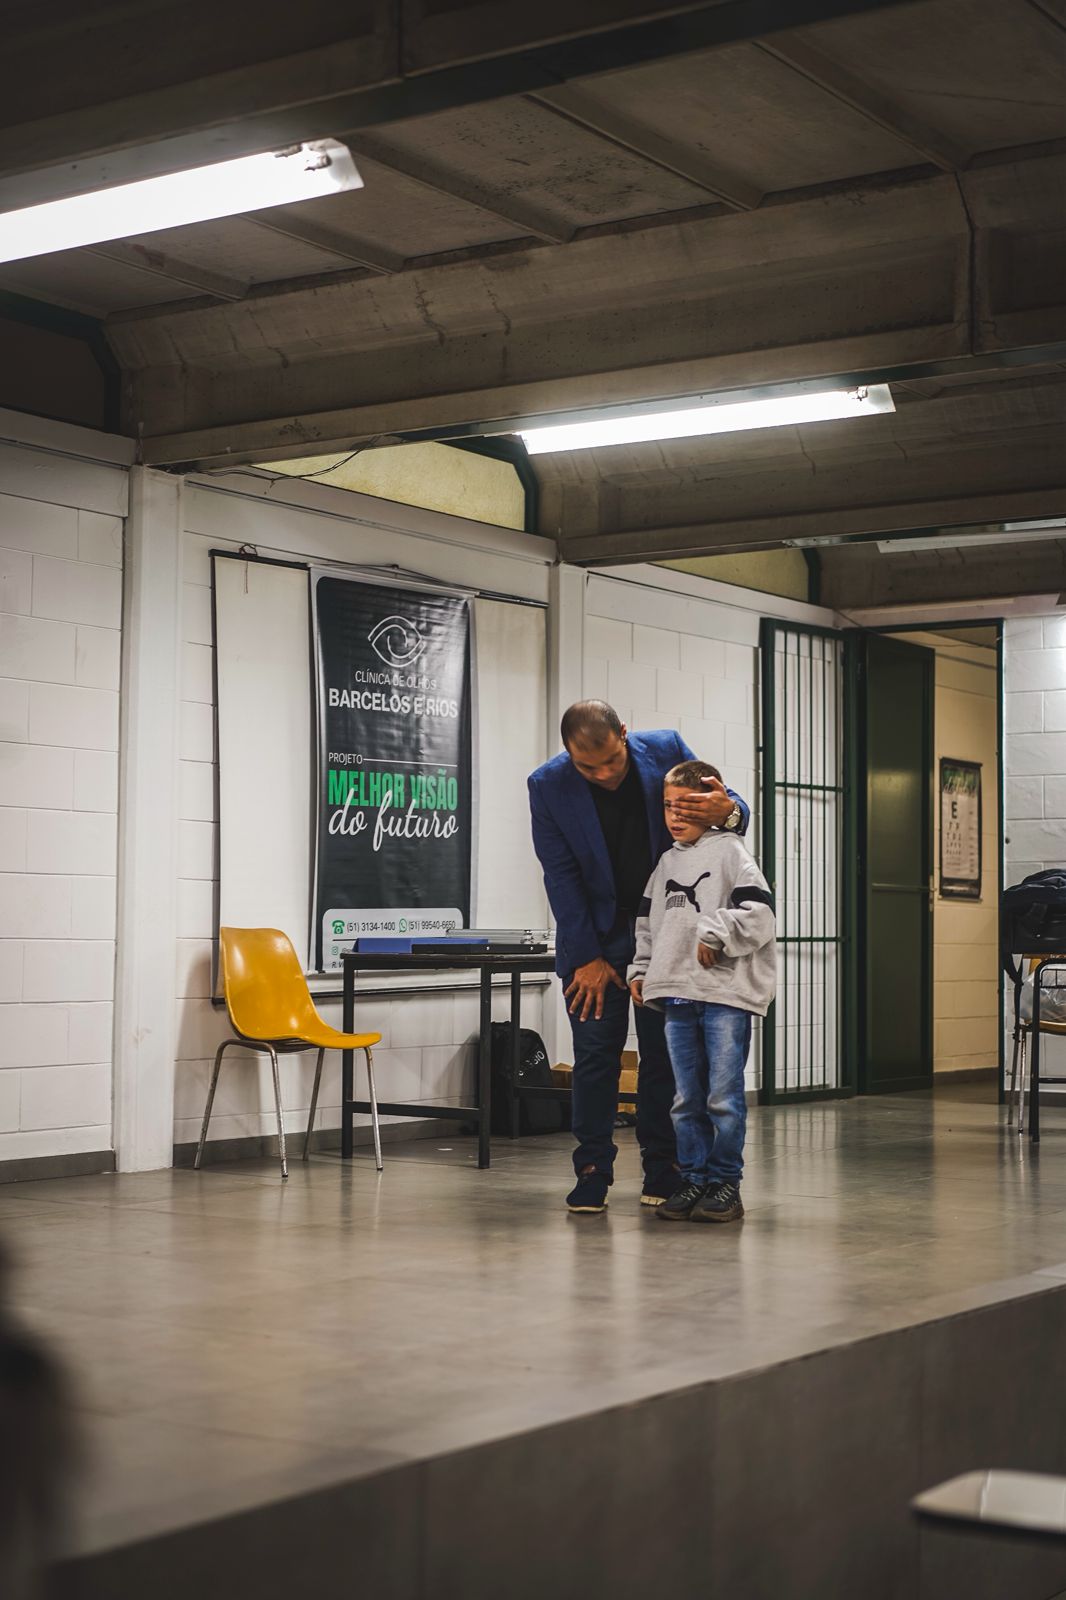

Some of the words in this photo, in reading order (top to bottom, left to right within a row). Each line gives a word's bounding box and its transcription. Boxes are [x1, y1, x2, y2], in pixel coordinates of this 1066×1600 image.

[355, 668, 391, 686] CLÍNICA
[392, 674, 405, 687] DE
[406, 675, 437, 690] OLHOS
[328, 687, 411, 714] BARCELOS
[413, 696, 424, 715] E
[328, 752, 363, 766] PROJETO
[328, 769, 405, 809] MELHOR
[409, 768, 458, 811] VISÃO
[328, 787, 368, 836] do
[373, 789, 459, 852] futuro
[951, 801, 958, 819] E
[346, 922, 360, 933] (51)
[361, 921, 396, 932] 3134-1400
